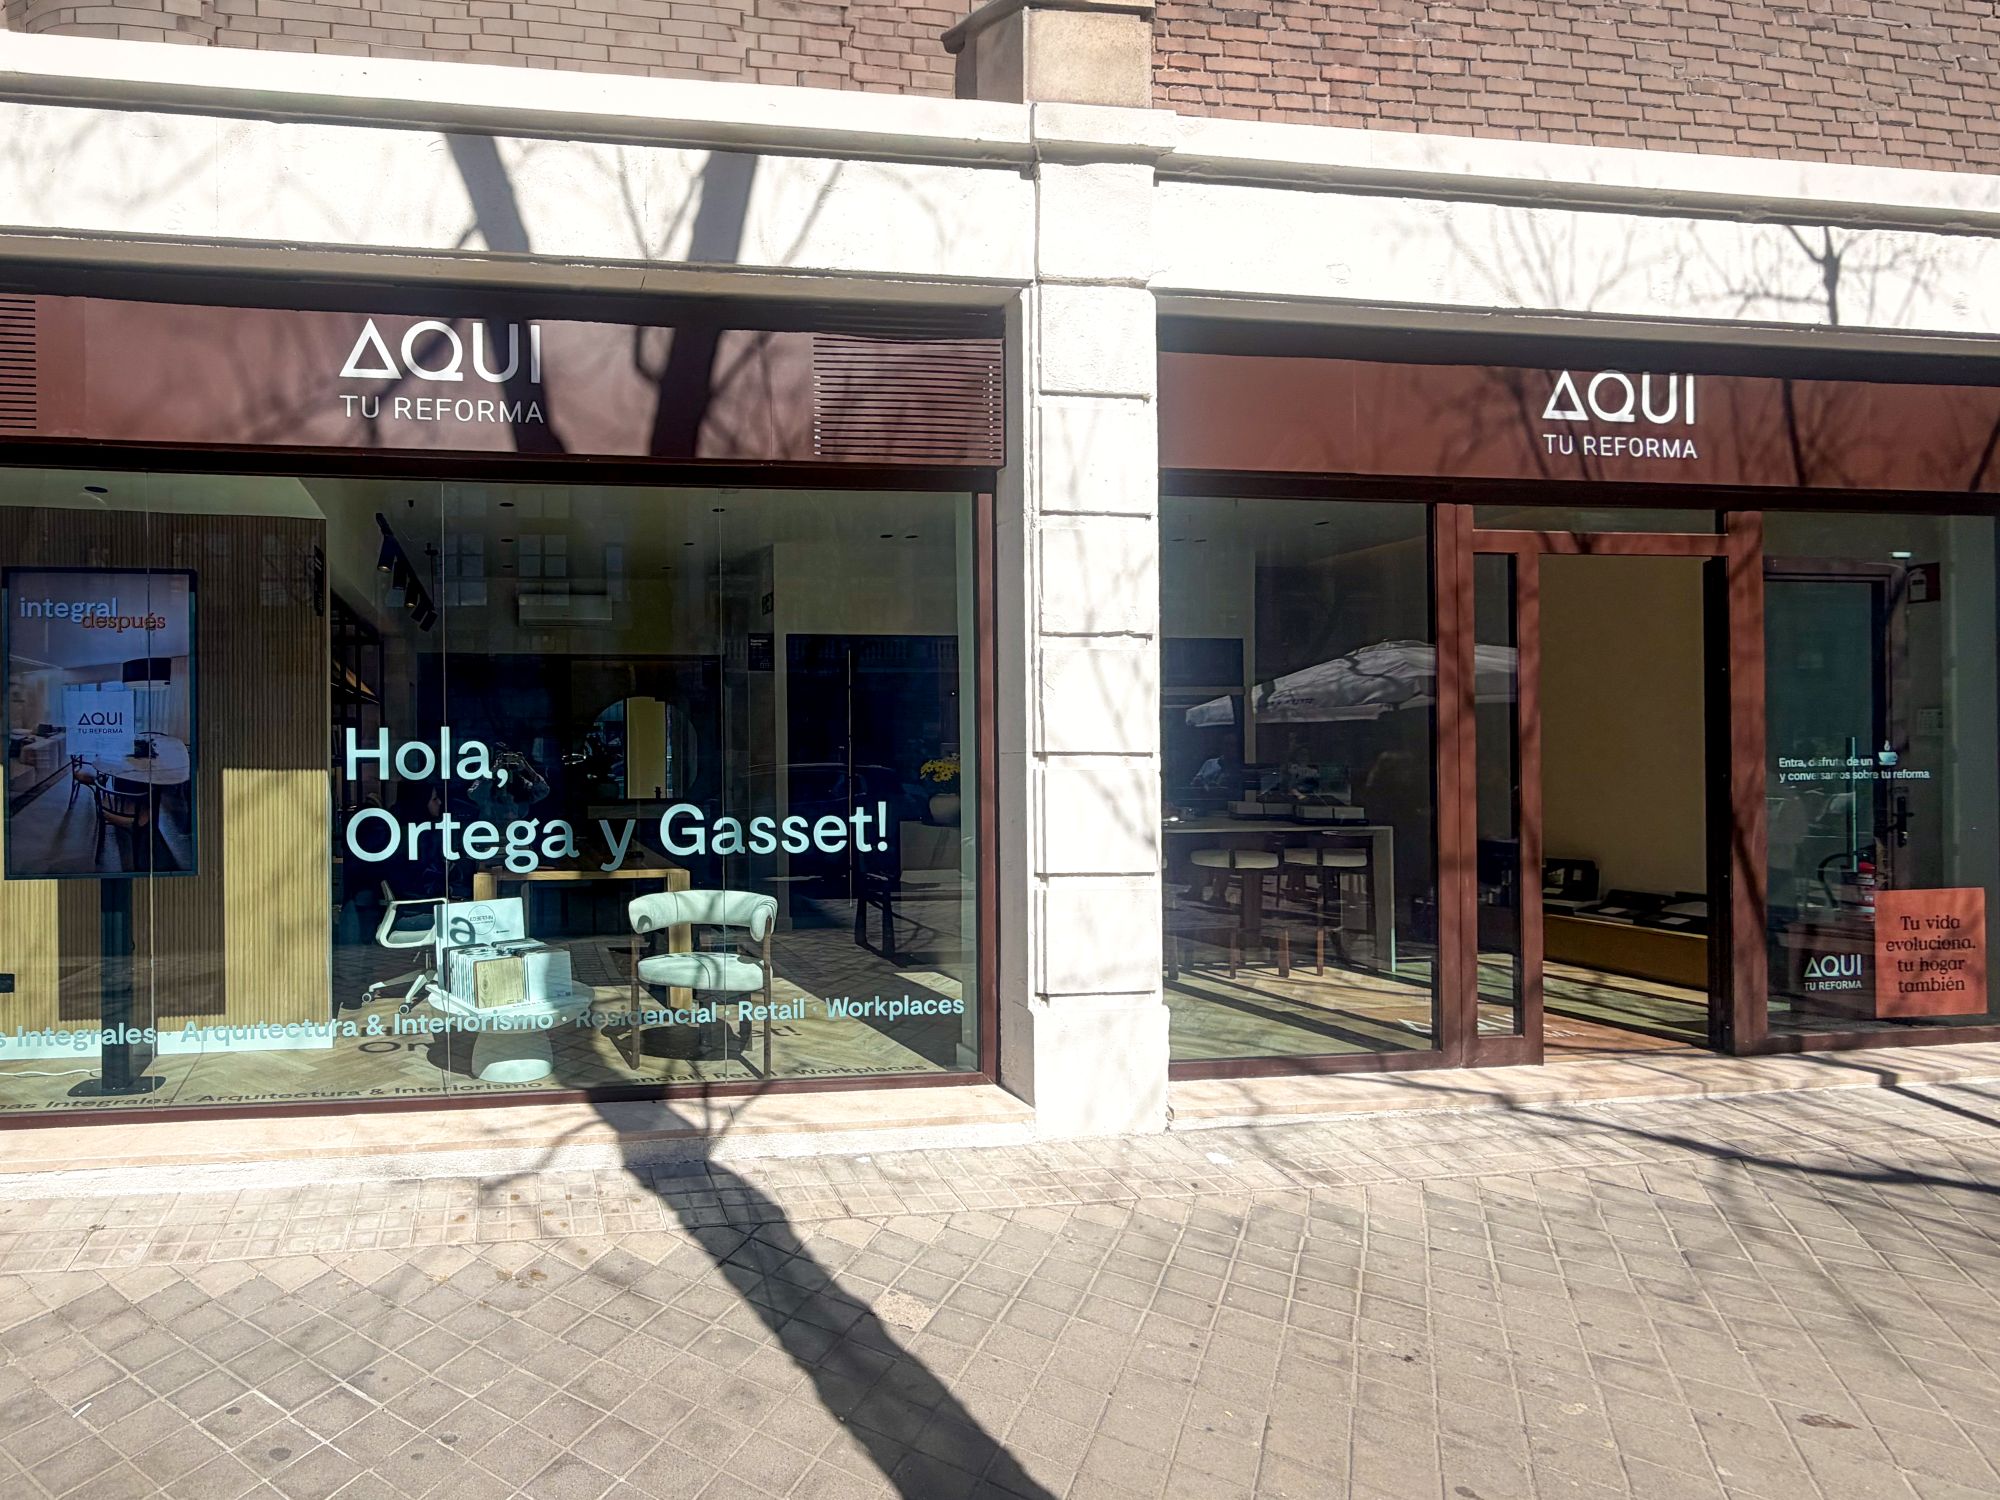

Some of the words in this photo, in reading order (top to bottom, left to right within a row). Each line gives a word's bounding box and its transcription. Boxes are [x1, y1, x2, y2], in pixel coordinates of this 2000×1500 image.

[339, 318, 541, 384] AQUI
[1542, 369, 1695, 425] AQUI
[339, 395, 380, 419] TU
[394, 397, 544, 424] REFORMA
[1543, 434, 1573, 455] TU
[1583, 436, 1698, 459] REFORMA
[20, 597, 118, 623] integral
[82, 612, 166, 633] después
[78, 712, 123, 726] AQUI
[346, 726, 509, 788] Hola,
[1779, 757, 1807, 768] Entra,
[1846, 757, 1860, 766] de
[1860, 758, 1873, 766] un
[1779, 772, 1786, 783] y
[1852, 769, 1879, 779] sobre
[1880, 770, 1891, 778] tu
[1893, 769, 1930, 778] reforma
[346, 807, 580, 874] Ortega
[599, 819, 636, 872] y
[659, 801, 889, 856] Gasset!
[1900, 915, 1920, 931] Tu
[1925, 915, 1960, 930] vida
[1804, 954, 1862, 978] AQUI
[1898, 959, 1914, 972] tu
[1919, 957, 1965, 975] hogar
[1805, 983, 1816, 991] TU
[1818, 980, 1862, 990] REFORMA
[1898, 976, 1965, 993] también
[16, 1022, 157, 1051] Integrales
[181, 1018, 358, 1046] Arquitectura
[366, 1014, 384, 1036] &
[394, 1009, 555, 1036] Interiorismo
[576, 1001, 717, 1028] Residencial
[738, 999, 805, 1022] Retail
[826, 995, 965, 1020] Workplaces
